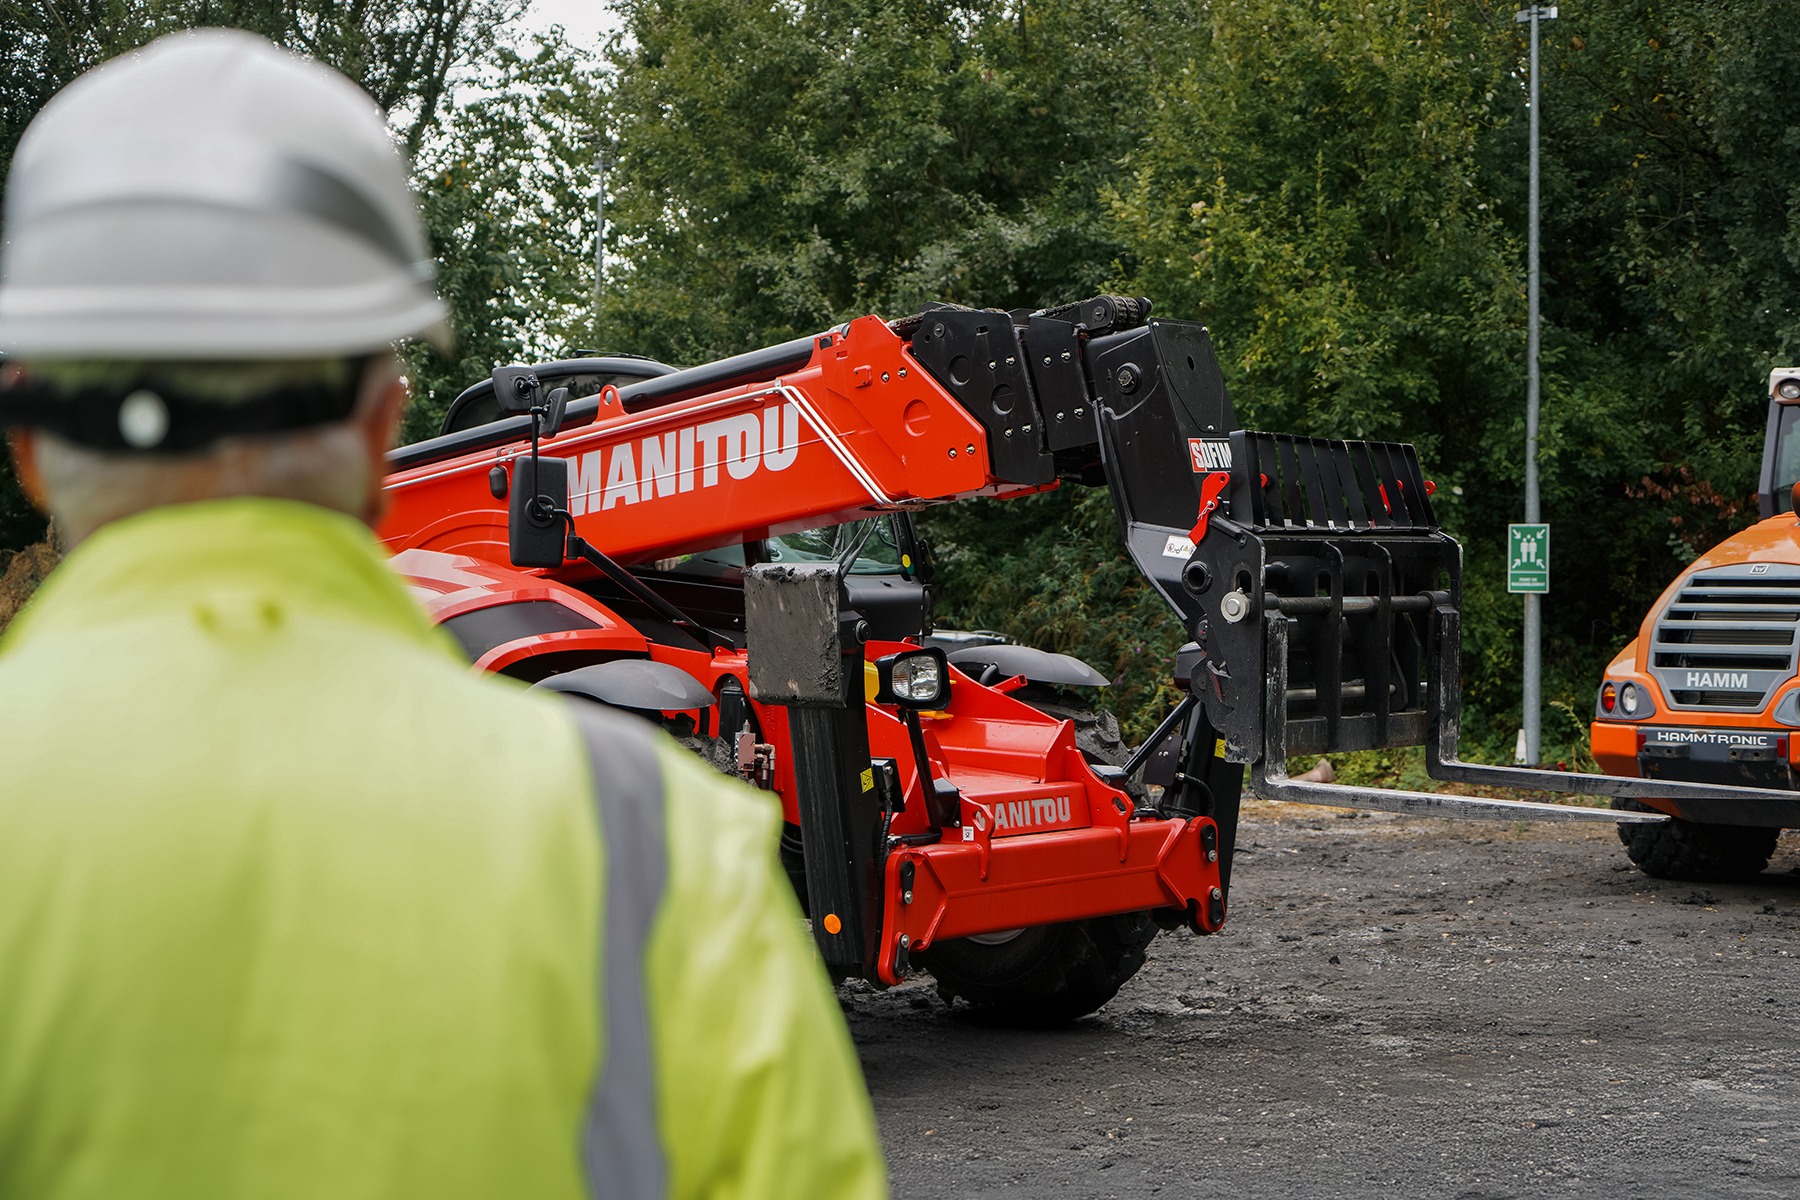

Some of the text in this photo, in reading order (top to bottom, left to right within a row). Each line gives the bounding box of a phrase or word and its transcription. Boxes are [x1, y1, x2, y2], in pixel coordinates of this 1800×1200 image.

[566, 402, 799, 518] MANITOU
[1686, 672, 1748, 689] HAMM
[1657, 731, 1768, 746] HAMMTRONIC
